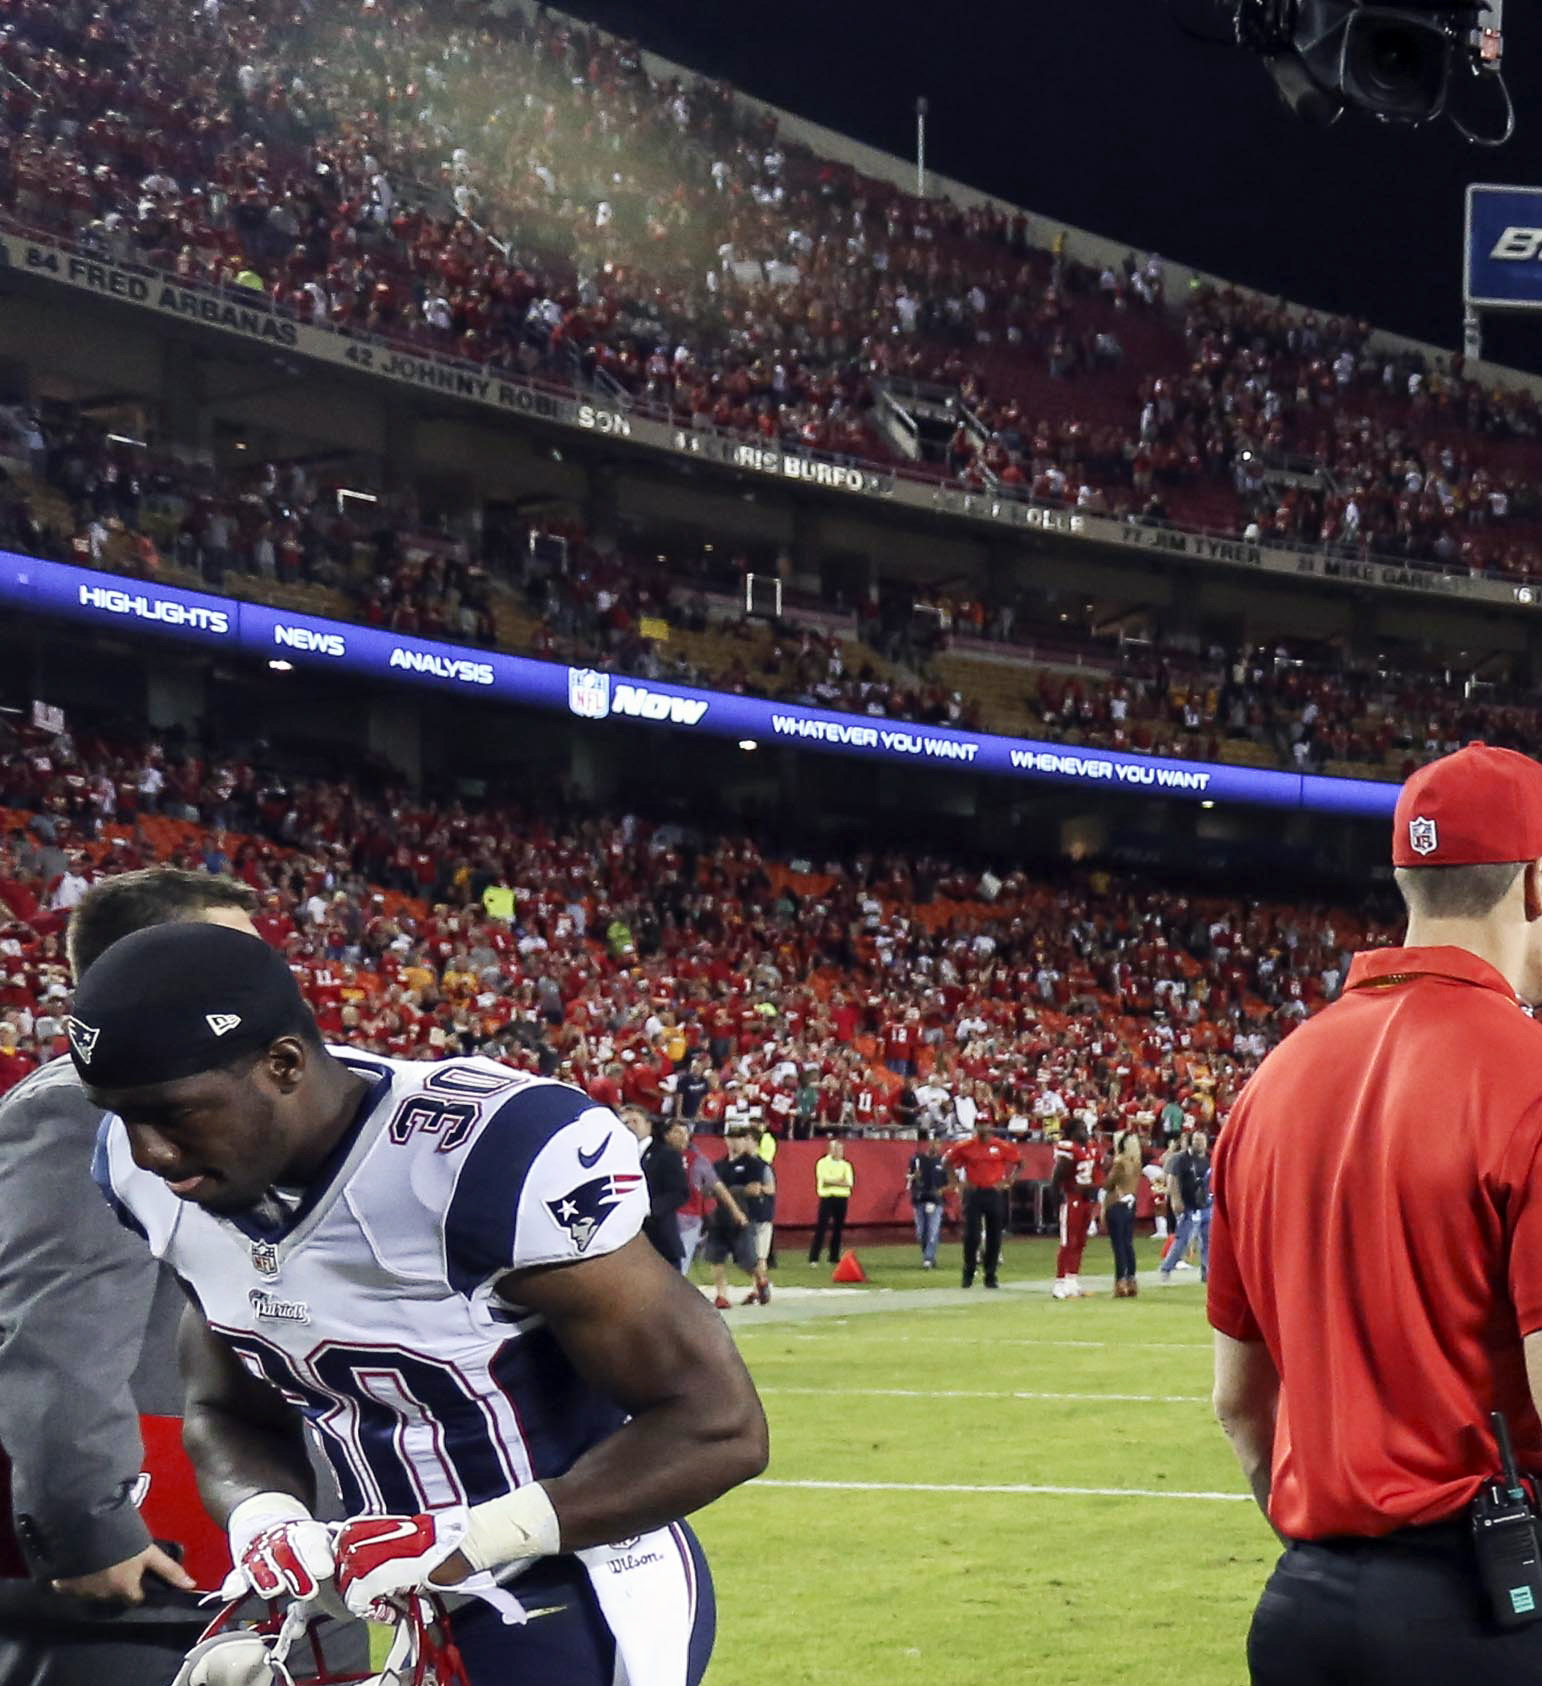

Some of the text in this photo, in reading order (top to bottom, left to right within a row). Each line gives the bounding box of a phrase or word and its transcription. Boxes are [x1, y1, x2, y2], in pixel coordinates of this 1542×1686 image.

[69, 257, 150, 300] FRED
[158, 284, 299, 348] ARBANAS
[381, 356, 490, 398] JOHNNY
[500, 386, 632, 437] ROBISON
[79, 583, 496, 686] HIGHLIGHTS NEWS ANALYSIS
[771, 714, 979, 762] WHATEVER YOU WANT
[1010, 750, 1211, 791] WHENEVER YOU WANT
[390, 1063, 529, 1154] 30
[606, 1551, 658, 1575] Wilson
